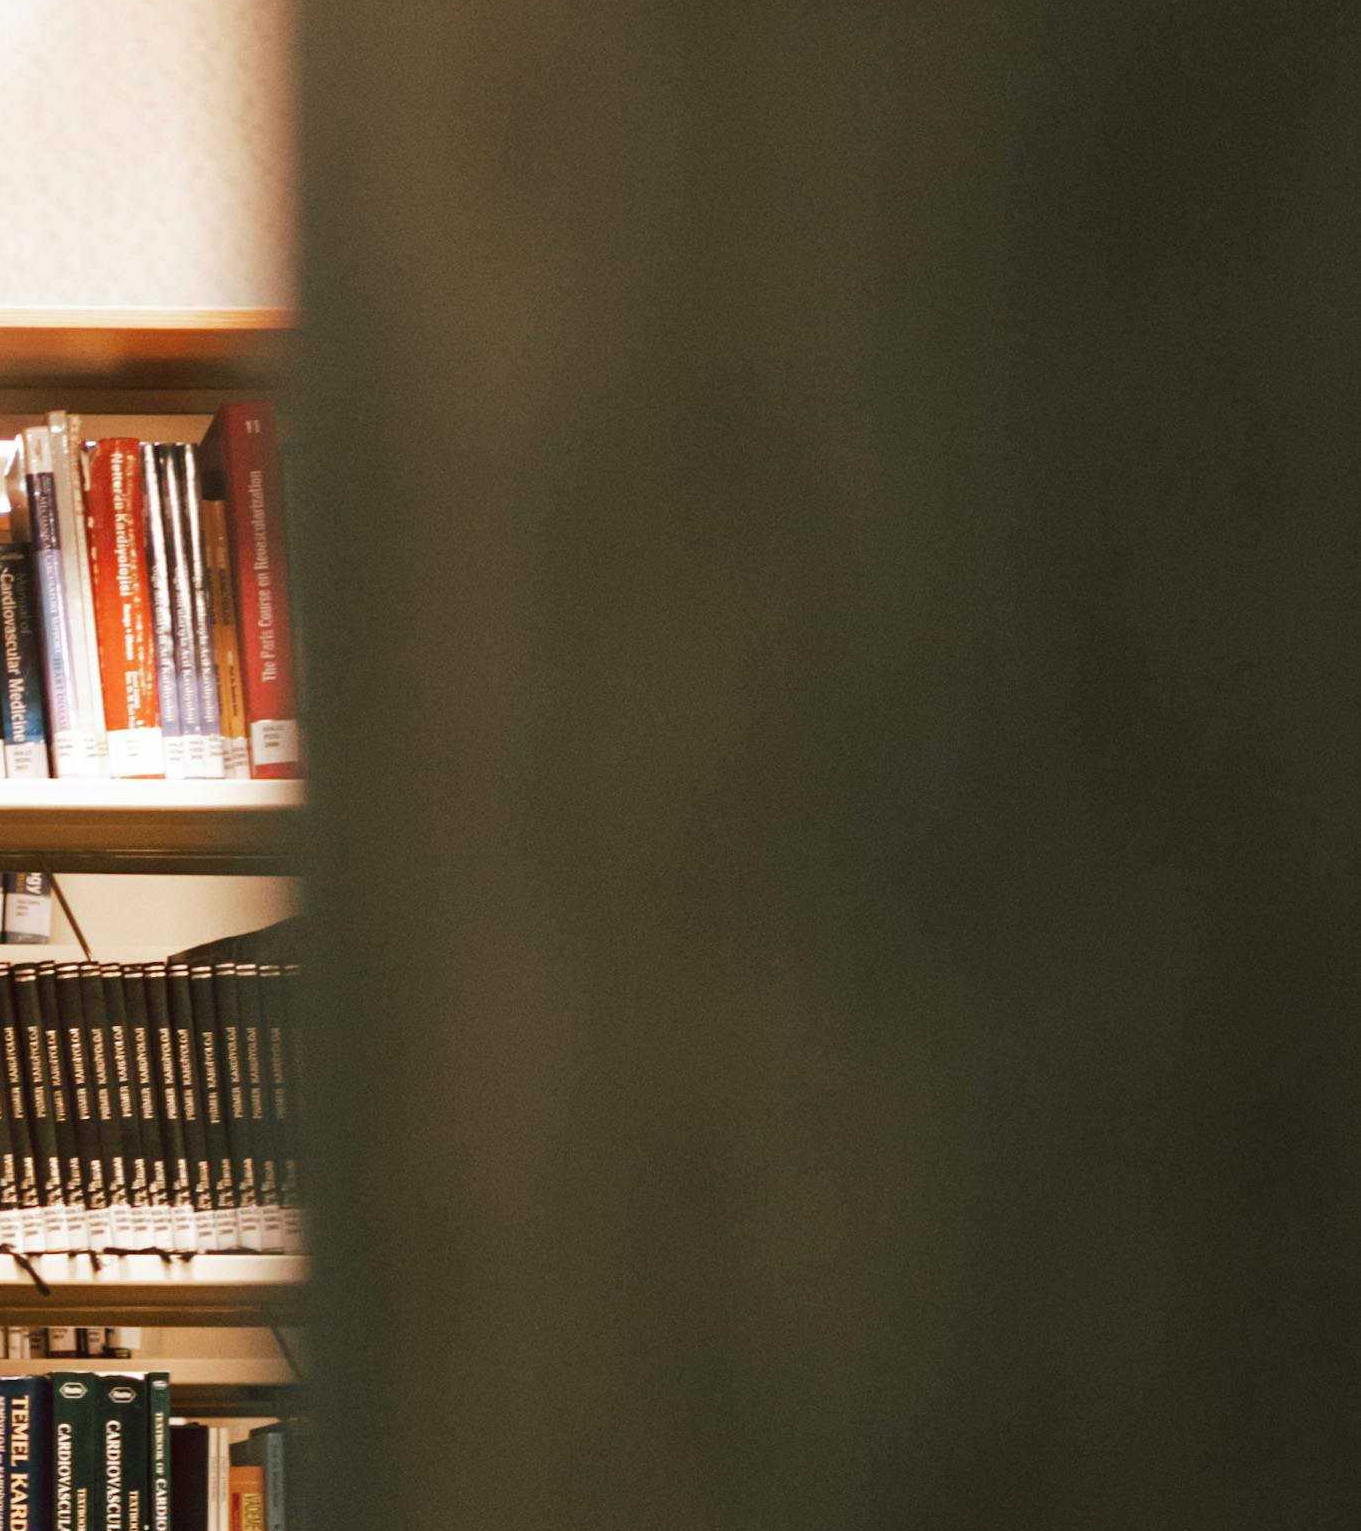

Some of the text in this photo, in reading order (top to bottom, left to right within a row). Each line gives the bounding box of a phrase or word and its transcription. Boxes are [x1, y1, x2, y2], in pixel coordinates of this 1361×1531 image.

[249, 471, 276, 682] The Paris Course on Revascularization
[10, 1395, 29, 1467] TEMEL
